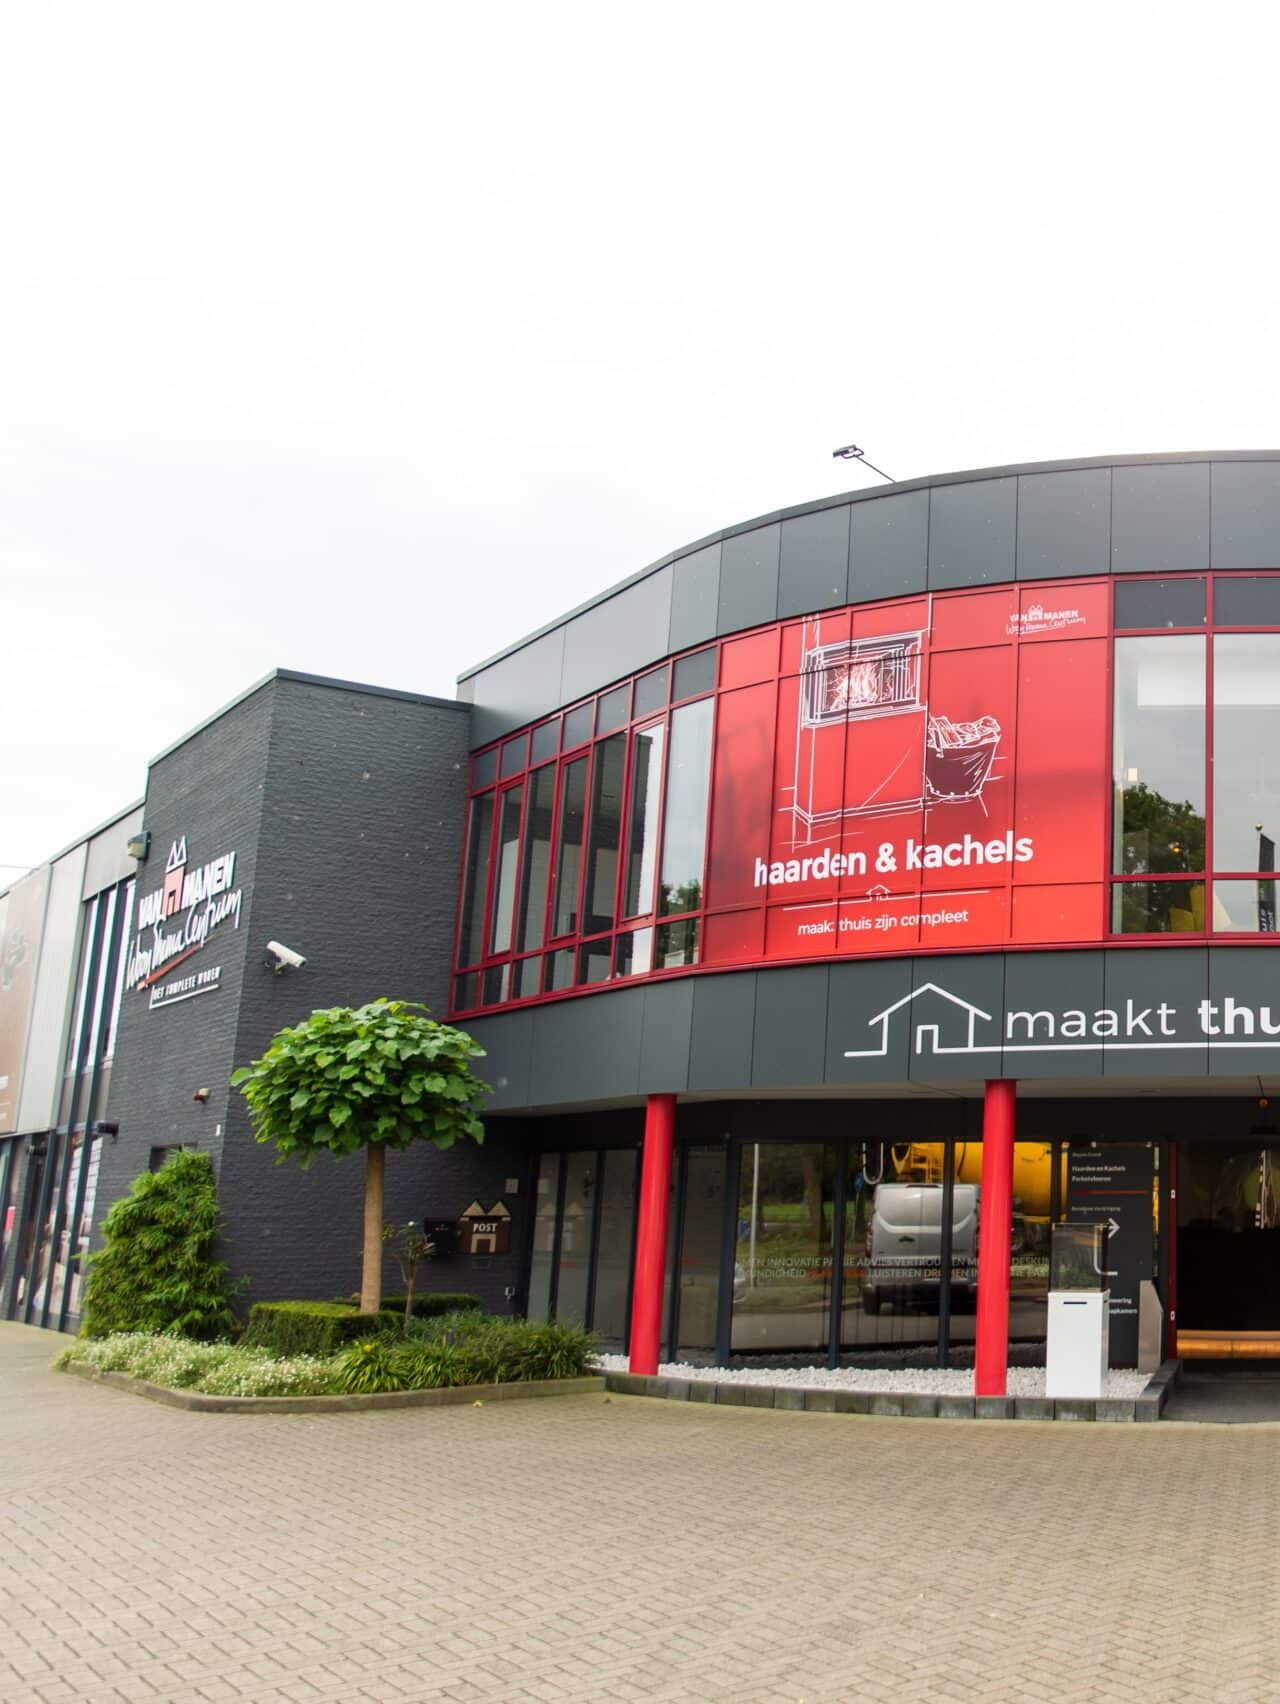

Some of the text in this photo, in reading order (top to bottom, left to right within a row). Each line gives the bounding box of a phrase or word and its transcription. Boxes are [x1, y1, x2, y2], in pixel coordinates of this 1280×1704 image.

[1044, 609, 1079, 620] MANEN
[754, 830, 1034, 888] haarden & kachels
[138, 850, 237, 931] VAN MANEN
[839, 916, 872, 931] thuis
[874, 913, 898, 931] zijn
[901, 909, 969, 927] compleet
[165, 975, 197, 996] COMPLETE
[1006, 998, 1177, 1039] maakt
[472, 1223, 498, 1232] POST
